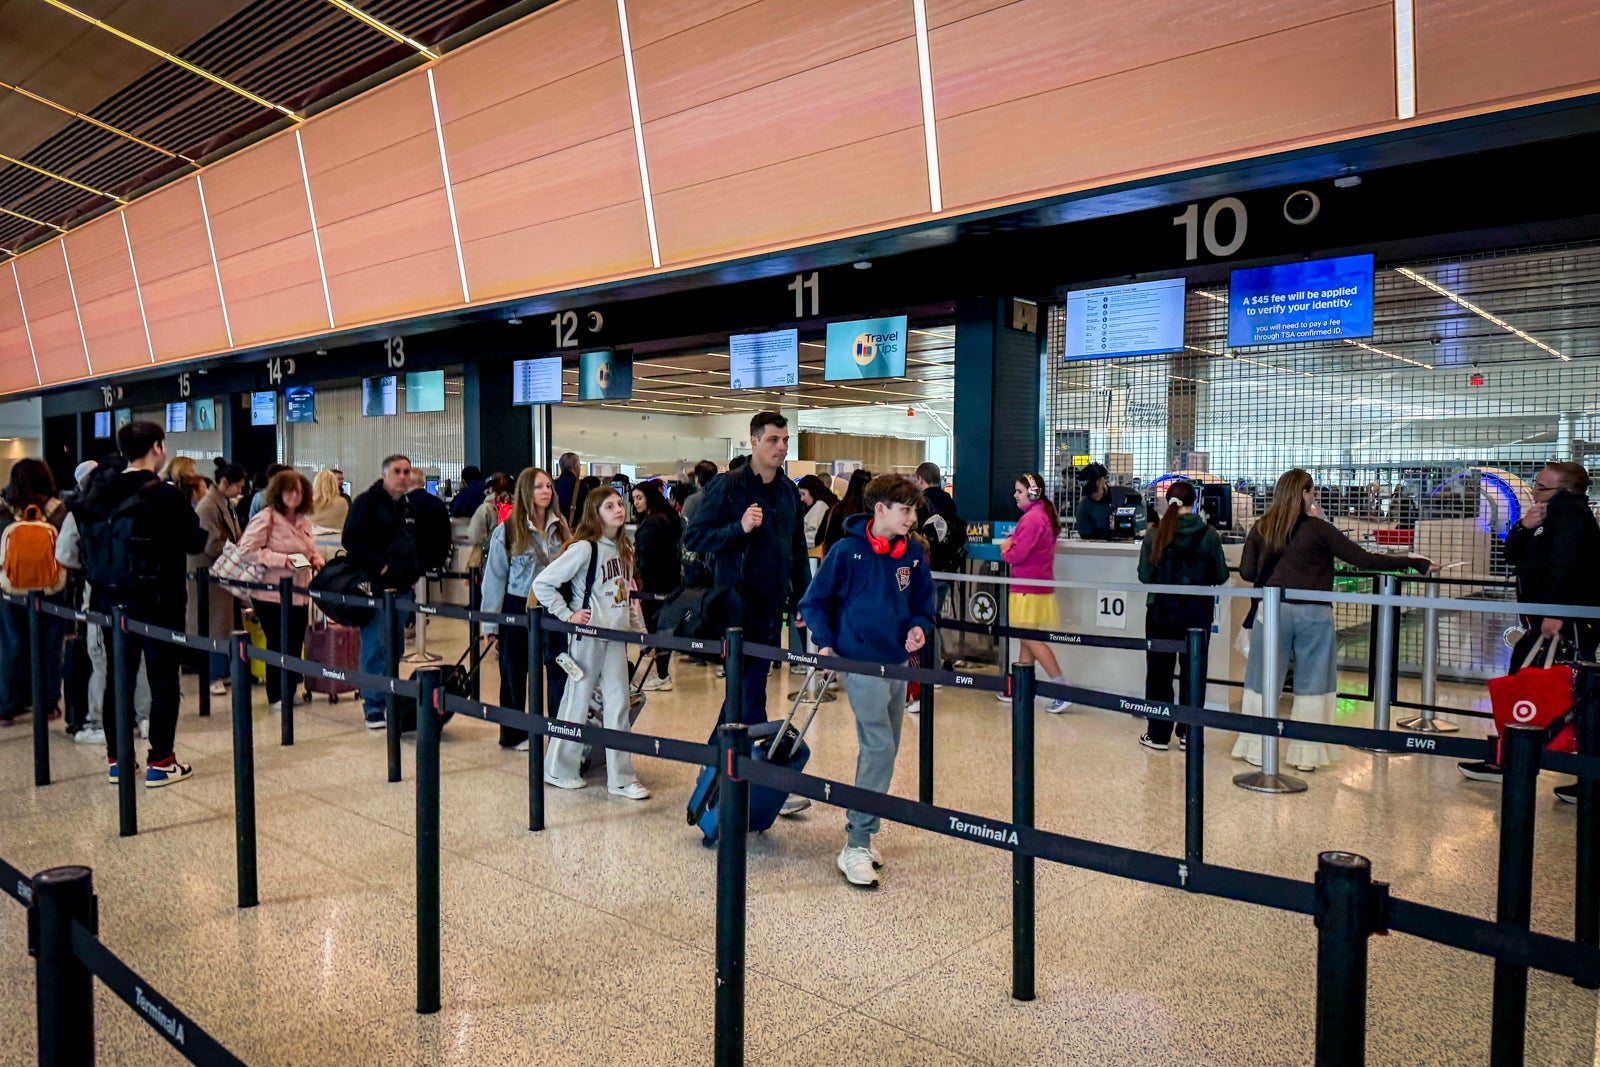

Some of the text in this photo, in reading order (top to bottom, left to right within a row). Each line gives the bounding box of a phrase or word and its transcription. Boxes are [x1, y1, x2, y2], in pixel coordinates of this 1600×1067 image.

[1173, 197, 1248, 260] 10
[788, 272, 819, 317] 11
[1243, 286, 1358, 305] A $45 fee will be applied
[1246, 297, 1353, 316] to verify your identity.
[551, 310, 579, 348] 12
[1254, 332, 1280, 341] through
[1296, 328, 1332, 337] confirmed
[1256, 326, 1269, 334] you
[1282, 322, 1299, 330] need
[1309, 320, 1322, 329] pay
[865, 331, 899, 343] Travel
[384, 337, 405, 368] 13
[876, 343, 898, 356] Tips
[267, 357, 282, 385] 14
[178, 372, 191, 397] 15
[1100, 597, 1125, 616] 10
[1049, 633, 1075, 643] Terminal
[787, 653, 818, 664] Terminal A
[956, 675, 973, 685] EWR
[1120, 700, 1170, 716] Terminal A
[547, 722, 582, 738] Terminal A
[1406, 737, 1436, 750] EWR
[949, 816, 1018, 845] Terminal A
[135, 986, 185, 1045] Terminal A
